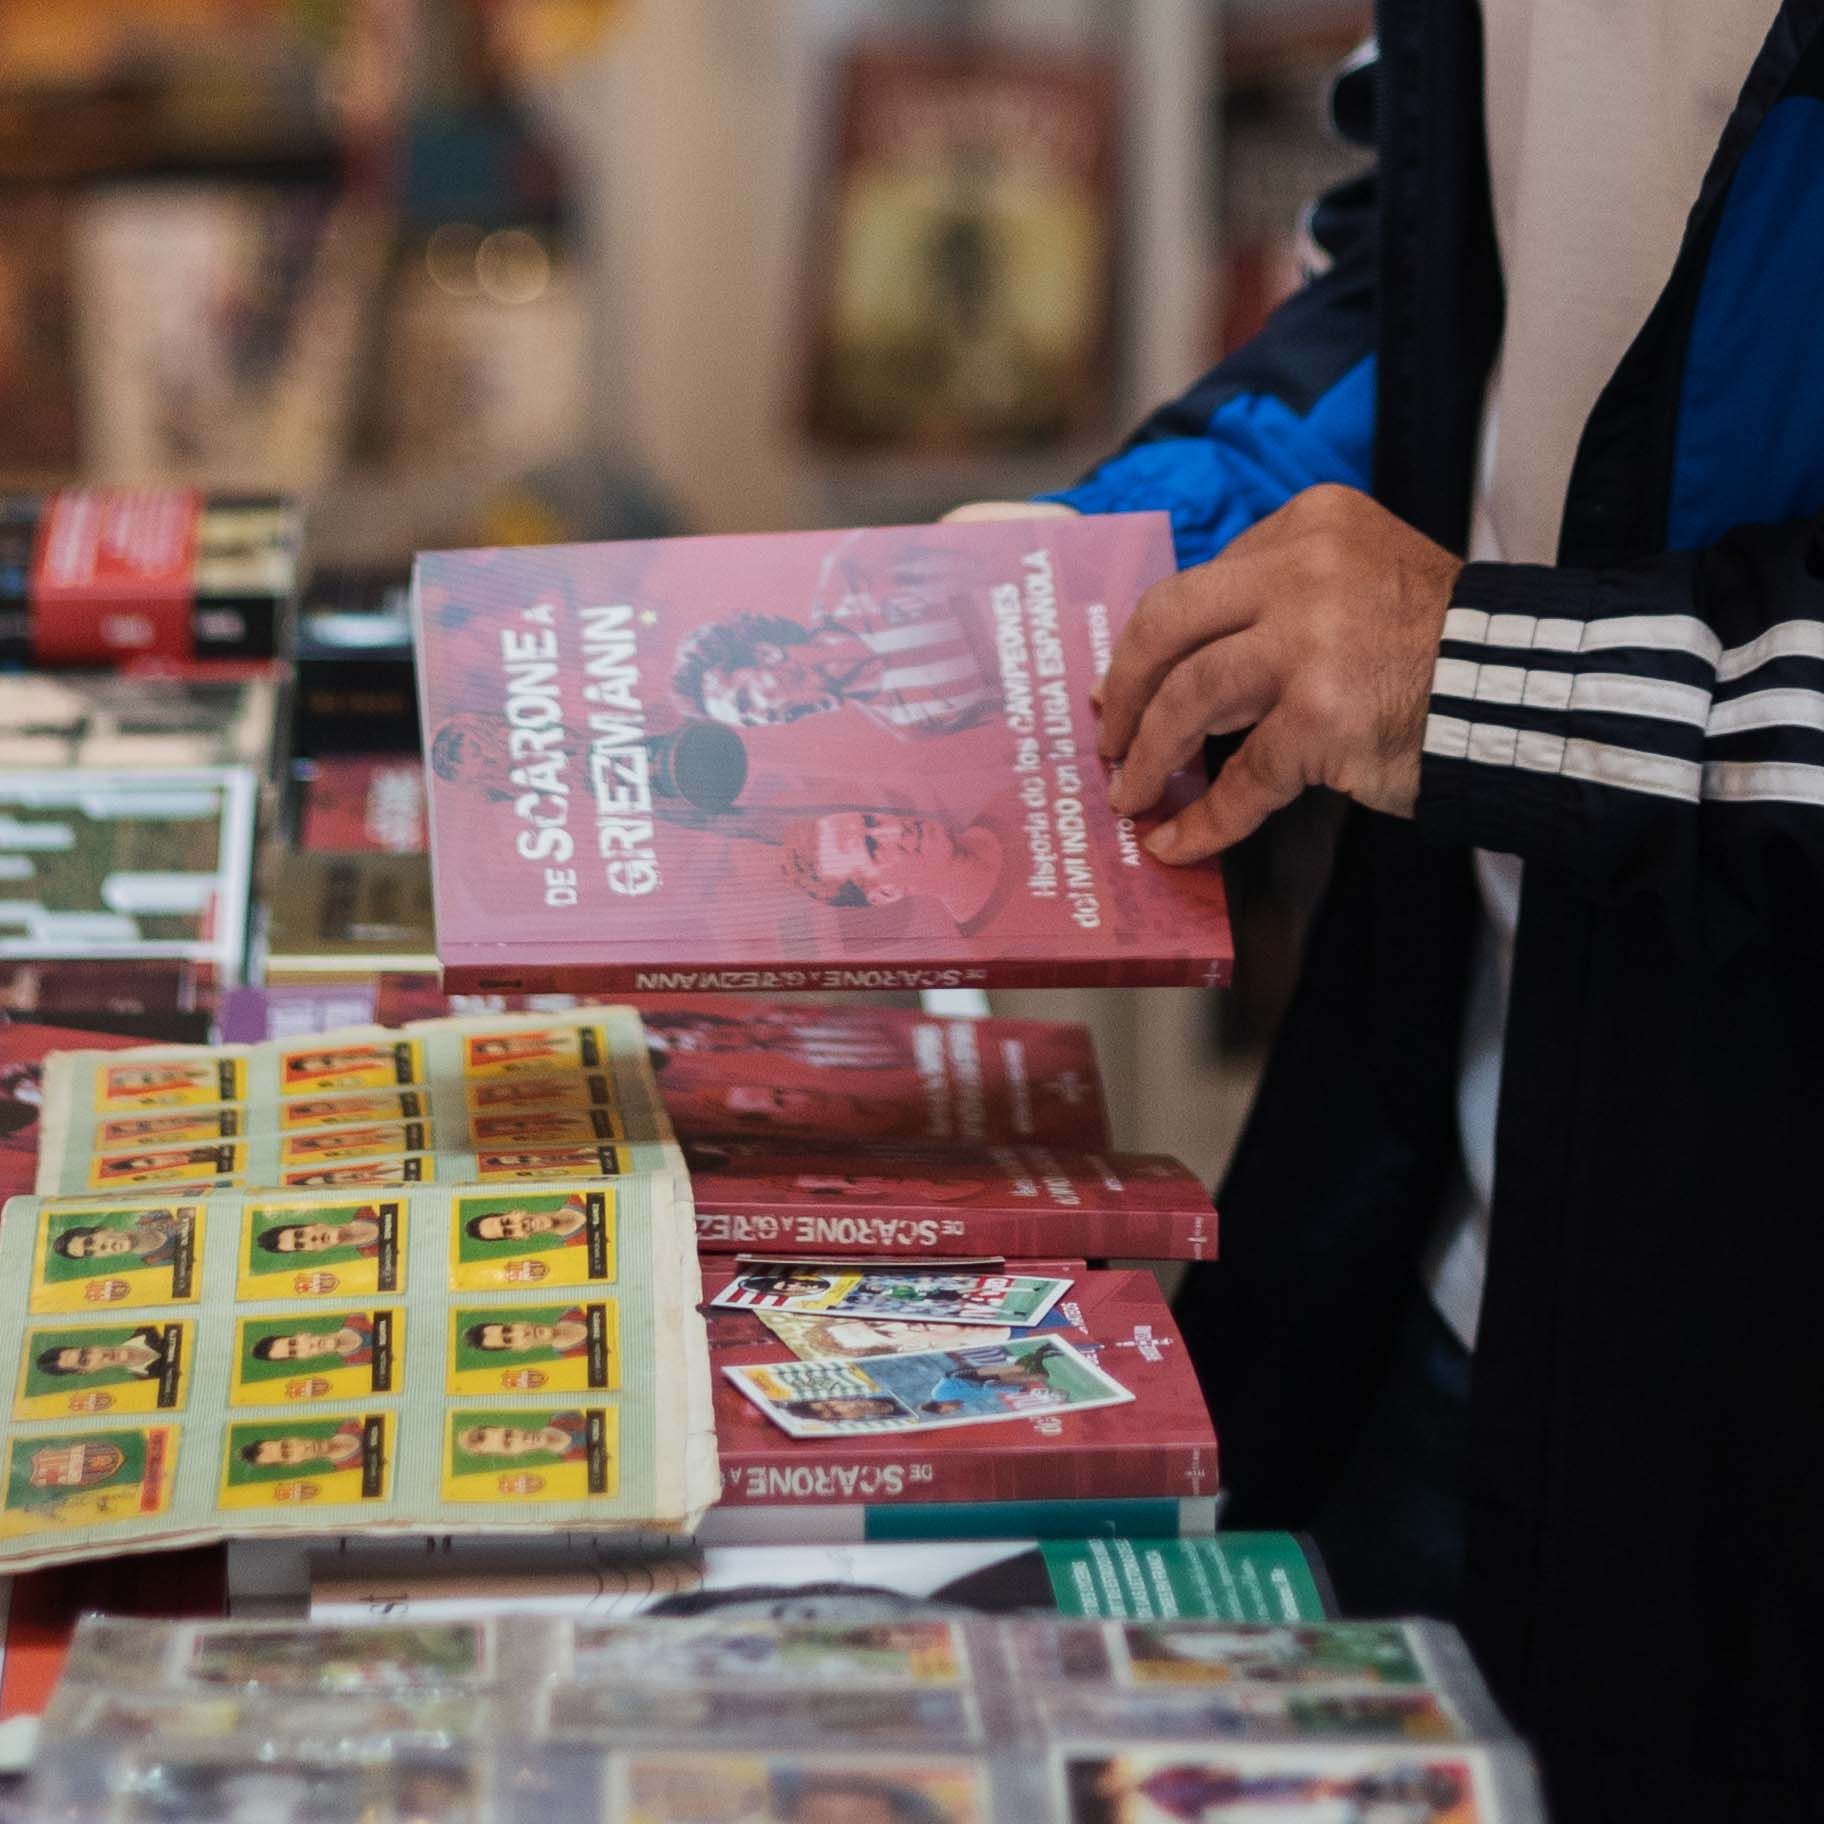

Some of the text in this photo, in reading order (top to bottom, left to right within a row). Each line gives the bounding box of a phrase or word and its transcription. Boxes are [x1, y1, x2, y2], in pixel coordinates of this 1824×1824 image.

[583, 603, 659, 899] GRIEZMANN
[992, 582, 1057, 899] Historia de los CAMPEONES
[1022, 548, 1102, 929] del MUNDO en la LIGA ESPAÑOLA
[501, 603, 578, 907] DE SCARONE A
[1116, 818, 1141, 868] ANTO
[636, 969, 807, 990] GRIEZMANN
[823, 968, 960, 989] SCARONE
[695, 1214, 779, 1242] GRIEZ
[796, 1216, 941, 1246] SCARONE
[941, 1220, 966, 1236] DE
[745, 1464, 906, 1497] SCARONE
[910, 1464, 934, 1482] DE
